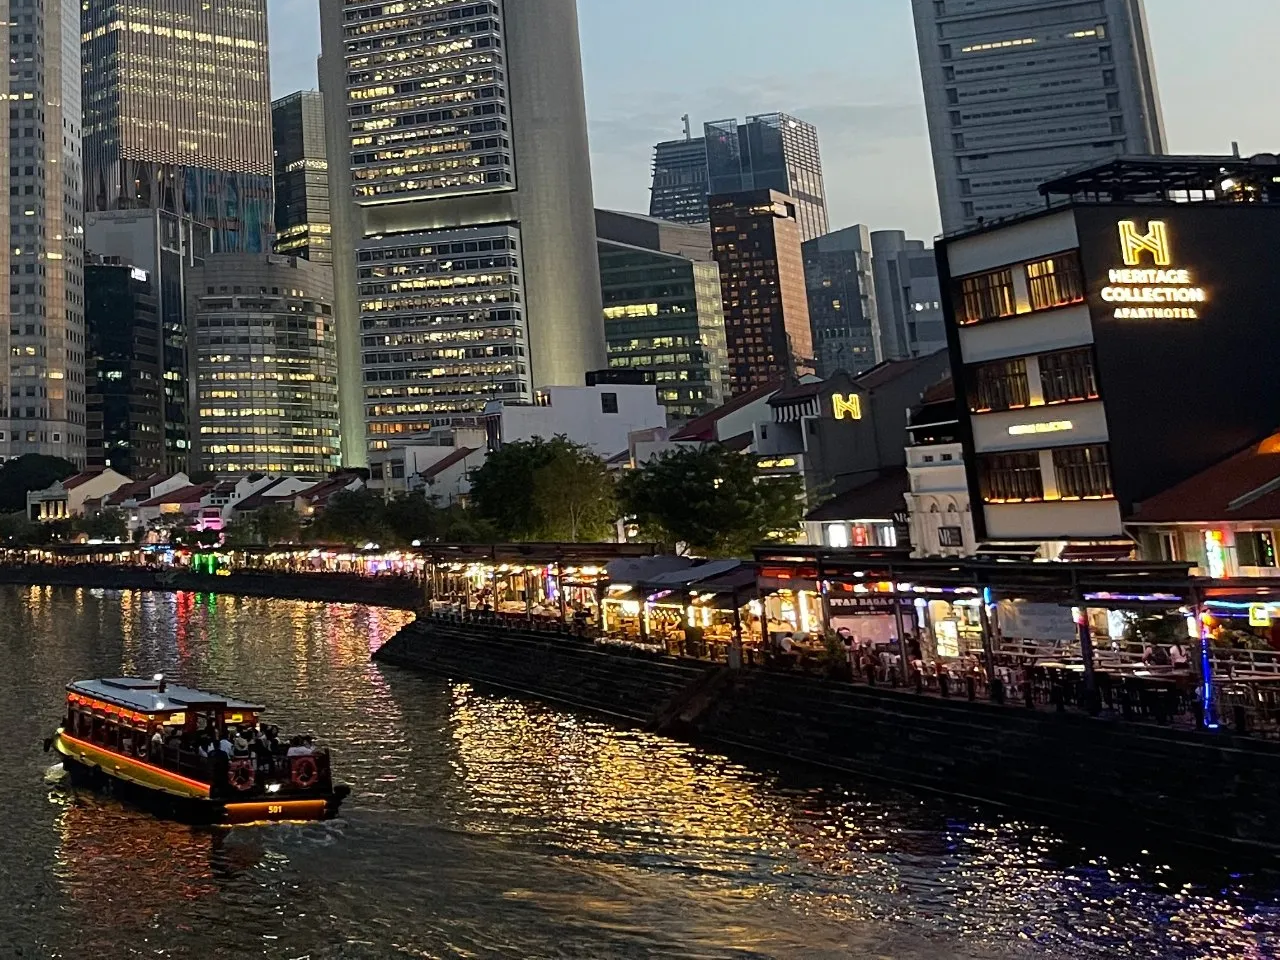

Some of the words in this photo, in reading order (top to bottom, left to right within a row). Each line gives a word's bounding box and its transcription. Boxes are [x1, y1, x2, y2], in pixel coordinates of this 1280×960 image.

[1108, 269, 1191, 283] HERITAGE
[1101, 287, 1206, 302] COLLECTION
[1113, 308, 1198, 318] APARTHOTEL
[268, 805, 283, 814] 501
